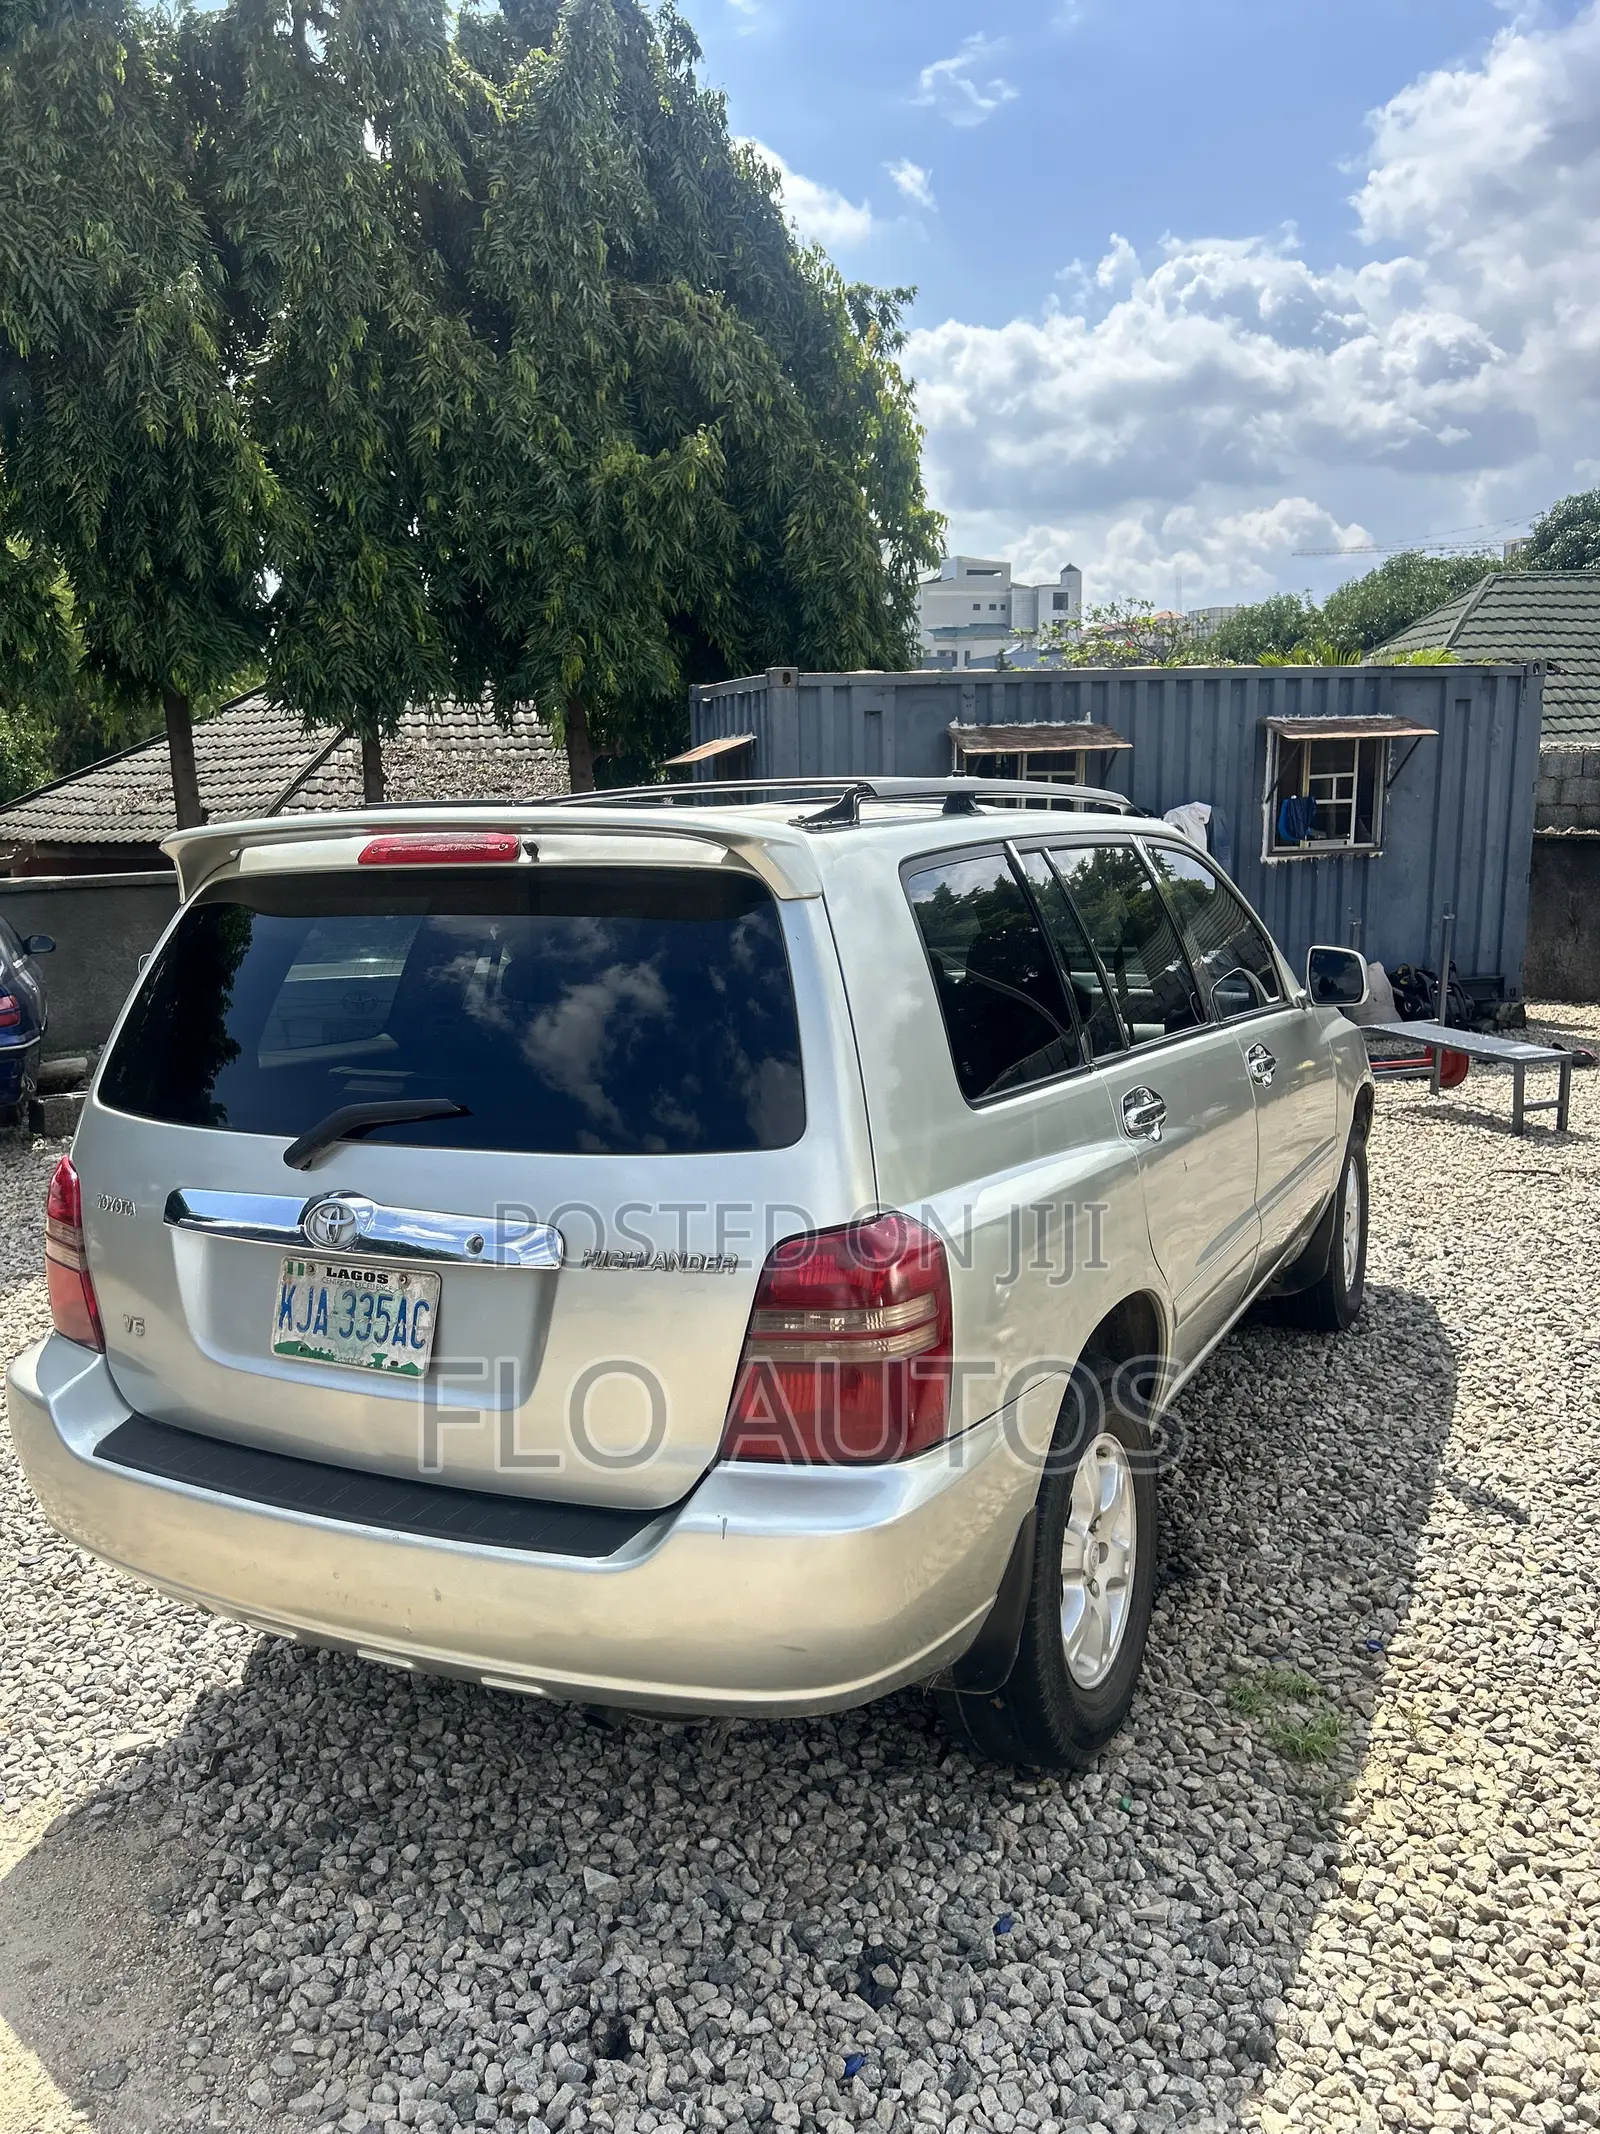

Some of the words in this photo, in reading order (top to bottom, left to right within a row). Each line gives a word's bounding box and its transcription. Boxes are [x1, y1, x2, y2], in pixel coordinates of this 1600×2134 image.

[97, 1193, 137, 1217] TOYOTA
[582, 1249, 739, 1275] HIGHLANDER
[321, 1276, 344, 1287] CENTRE
[326, 1266, 389, 1284] LAGOS
[123, 1314, 146, 1337] V6
